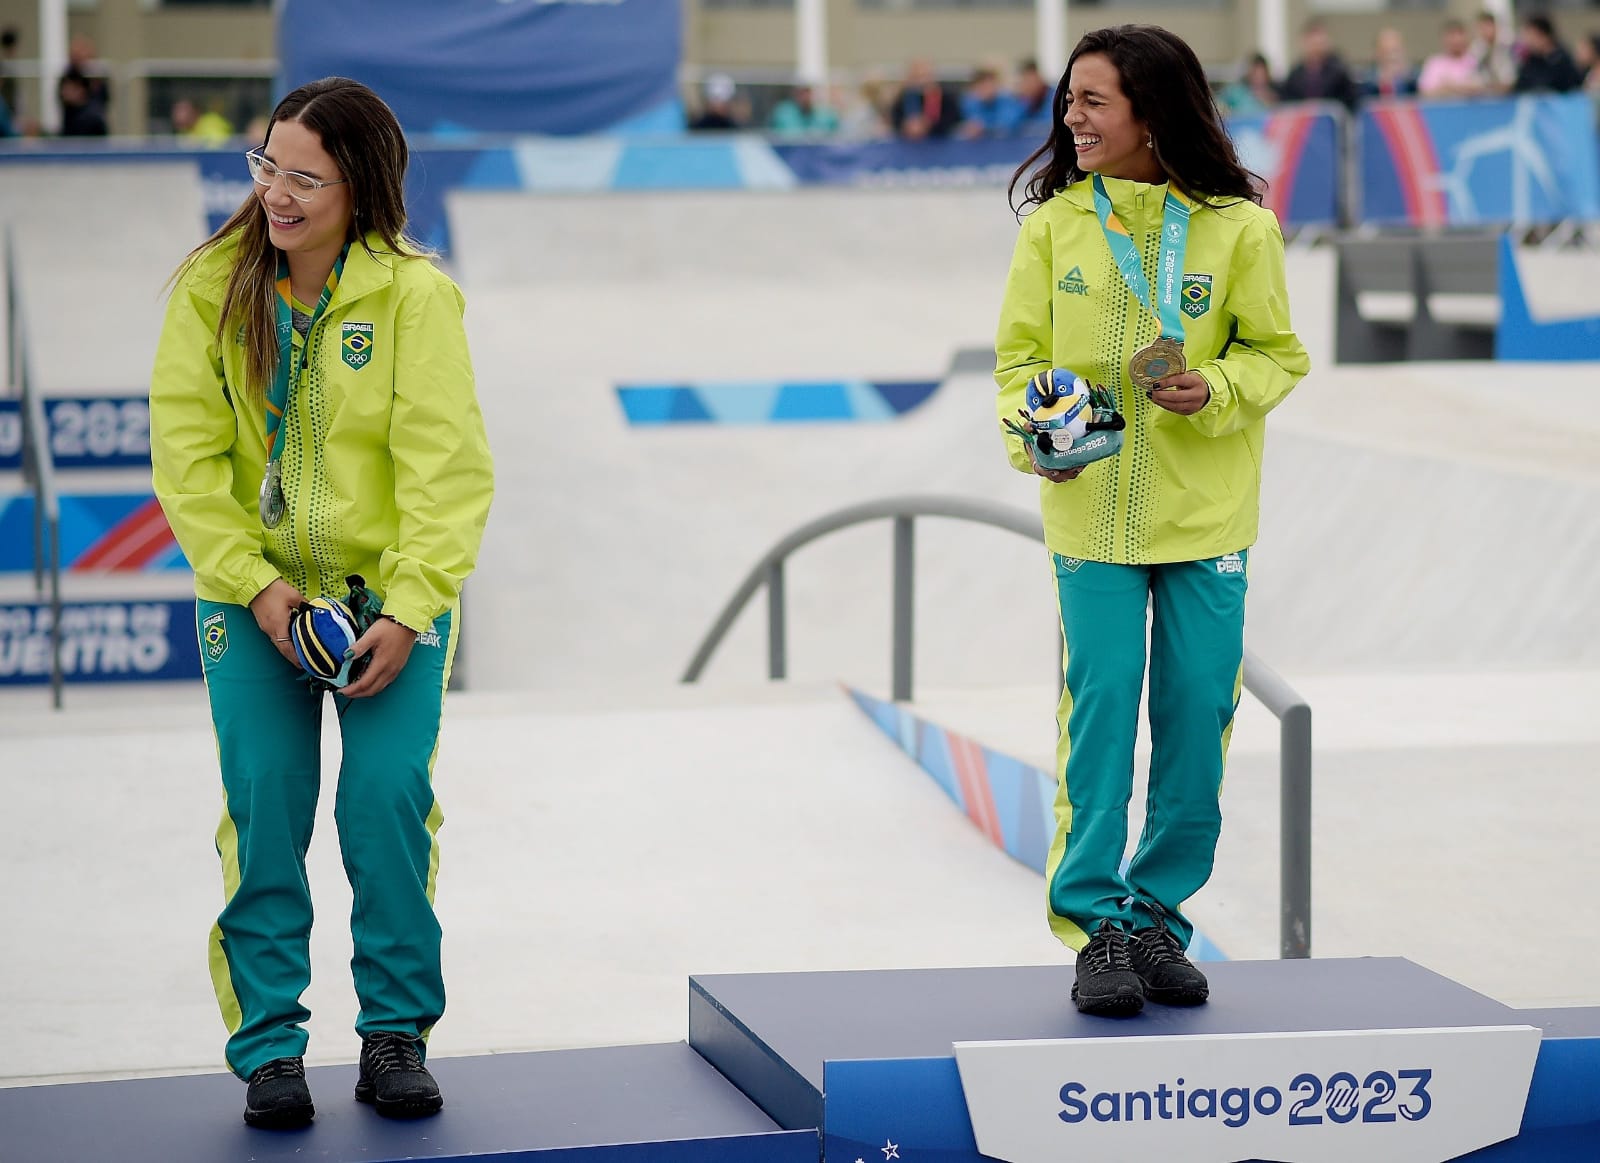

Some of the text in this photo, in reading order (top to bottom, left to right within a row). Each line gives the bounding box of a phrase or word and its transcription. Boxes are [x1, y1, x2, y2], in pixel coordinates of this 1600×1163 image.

[1183, 275, 1212, 283] BRASIL
[1058, 280, 1090, 296] PEAK
[343, 323, 373, 331] BRASIL
[1053, 445, 1086, 458] Santiago
[1086, 435, 1108, 451] 2023
[1215, 560, 1245, 574] PEAK
[203, 614, 224, 628] BRASIL
[1058, 1069, 1433, 1128] Santiago 2023
